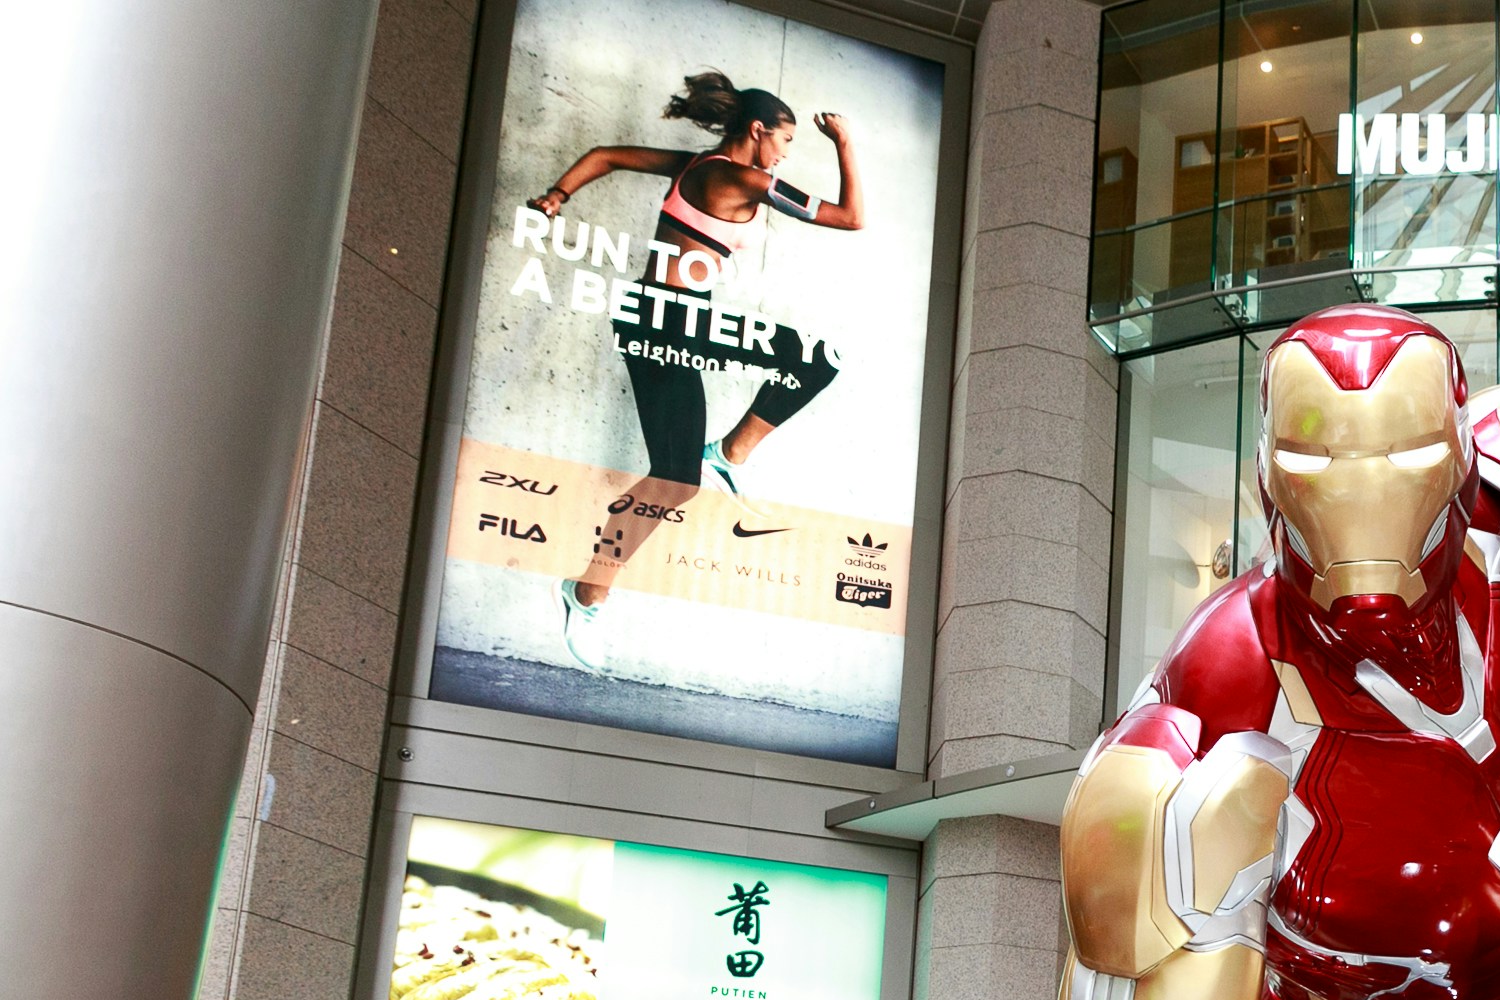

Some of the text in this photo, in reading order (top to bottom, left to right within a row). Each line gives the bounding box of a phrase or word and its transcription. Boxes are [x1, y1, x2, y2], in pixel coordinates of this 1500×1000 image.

[512, 206, 630, 274] RUN
[510, 257, 553, 304] A
[570, 268, 777, 356] BETTER
[613, 332, 719, 372] Leighton
[479, 470, 559, 496] 2XU
[633, 501, 686, 523] asics
[479, 513, 547, 543] FILA
[666, 552, 801, 587] JACK WILLS
[844, 557, 887, 572] adidas
[836, 572, 892, 589] Onitsuka
[841, 585, 886, 601] Tiger
[715, 880, 770, 978] 莆田
[711, 986, 767, 1000] PUTIEN
